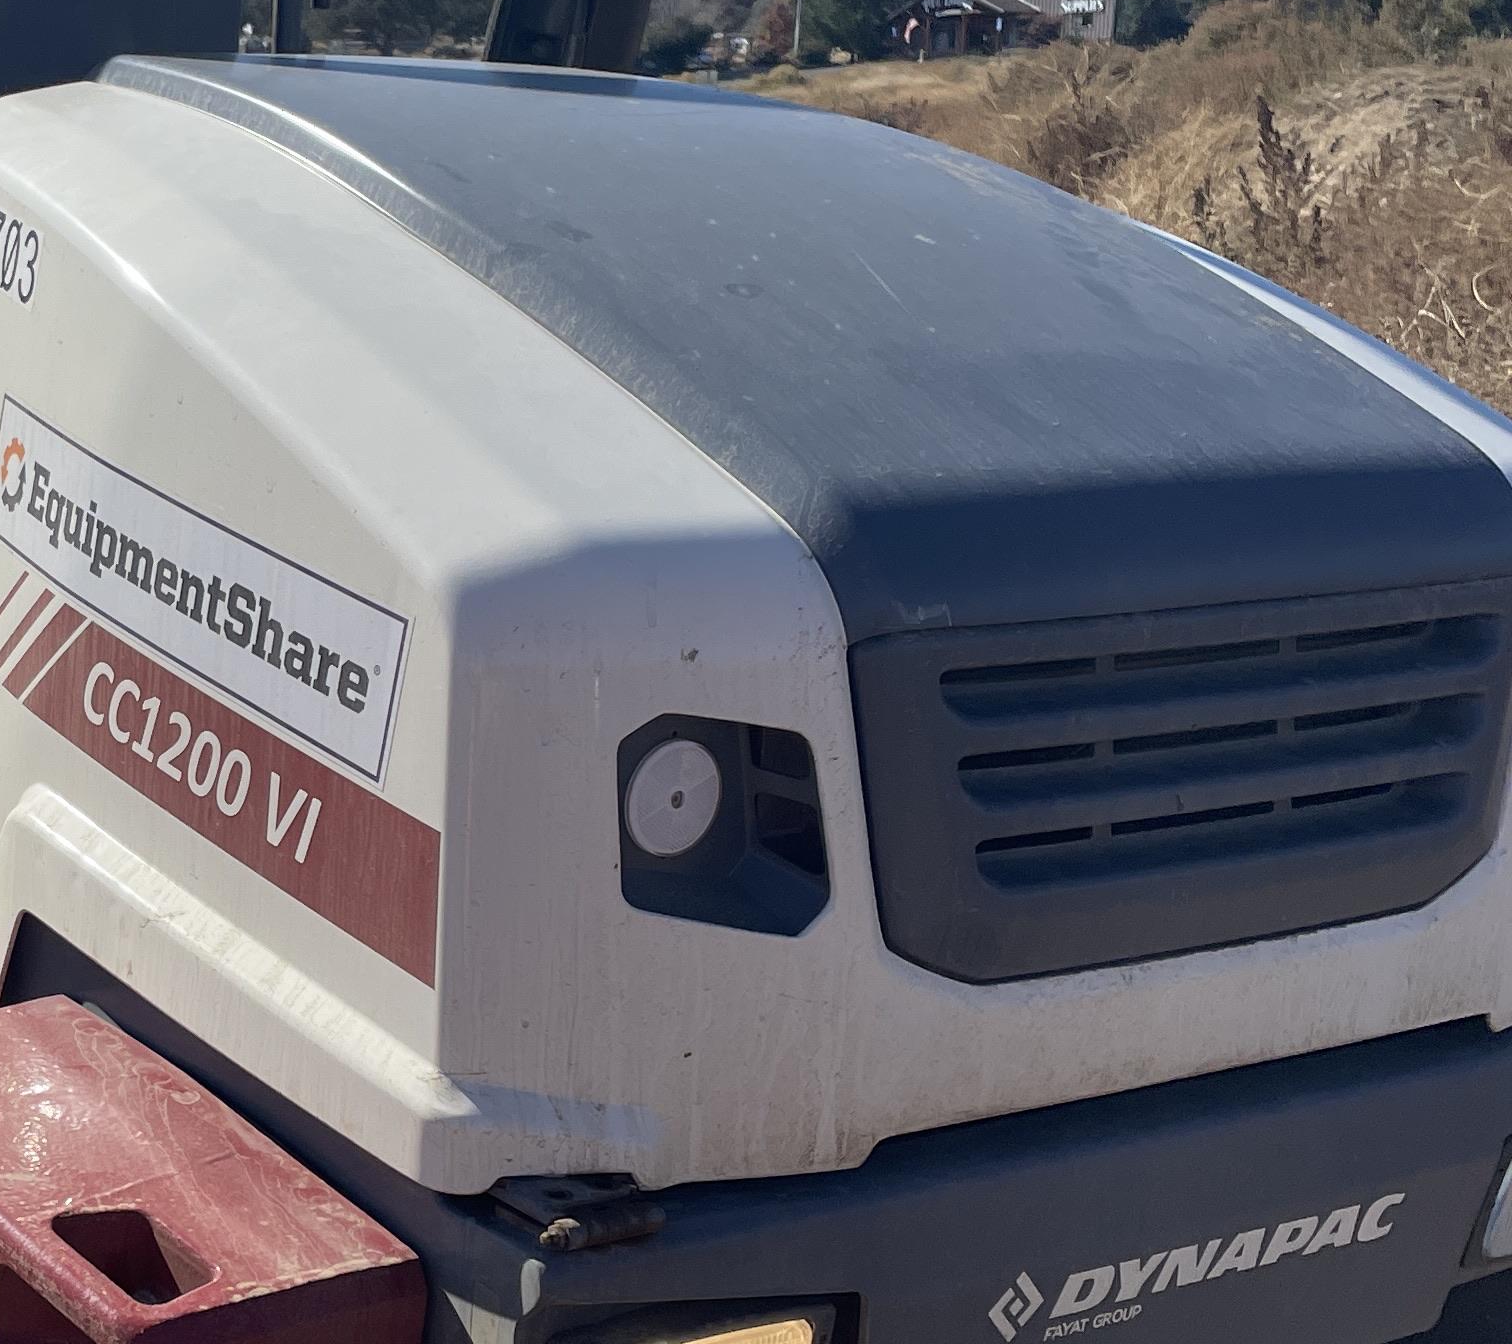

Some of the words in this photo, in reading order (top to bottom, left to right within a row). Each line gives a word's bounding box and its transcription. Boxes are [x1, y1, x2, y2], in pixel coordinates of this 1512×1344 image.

[82, 660, 252, 817] CC1200
[265, 771, 322, 864] VI
[1048, 1192, 1406, 1319] DYNAPAC
[1043, 1317, 1090, 1342] FAYAT
[1092, 1303, 1143, 1330] GROUP
